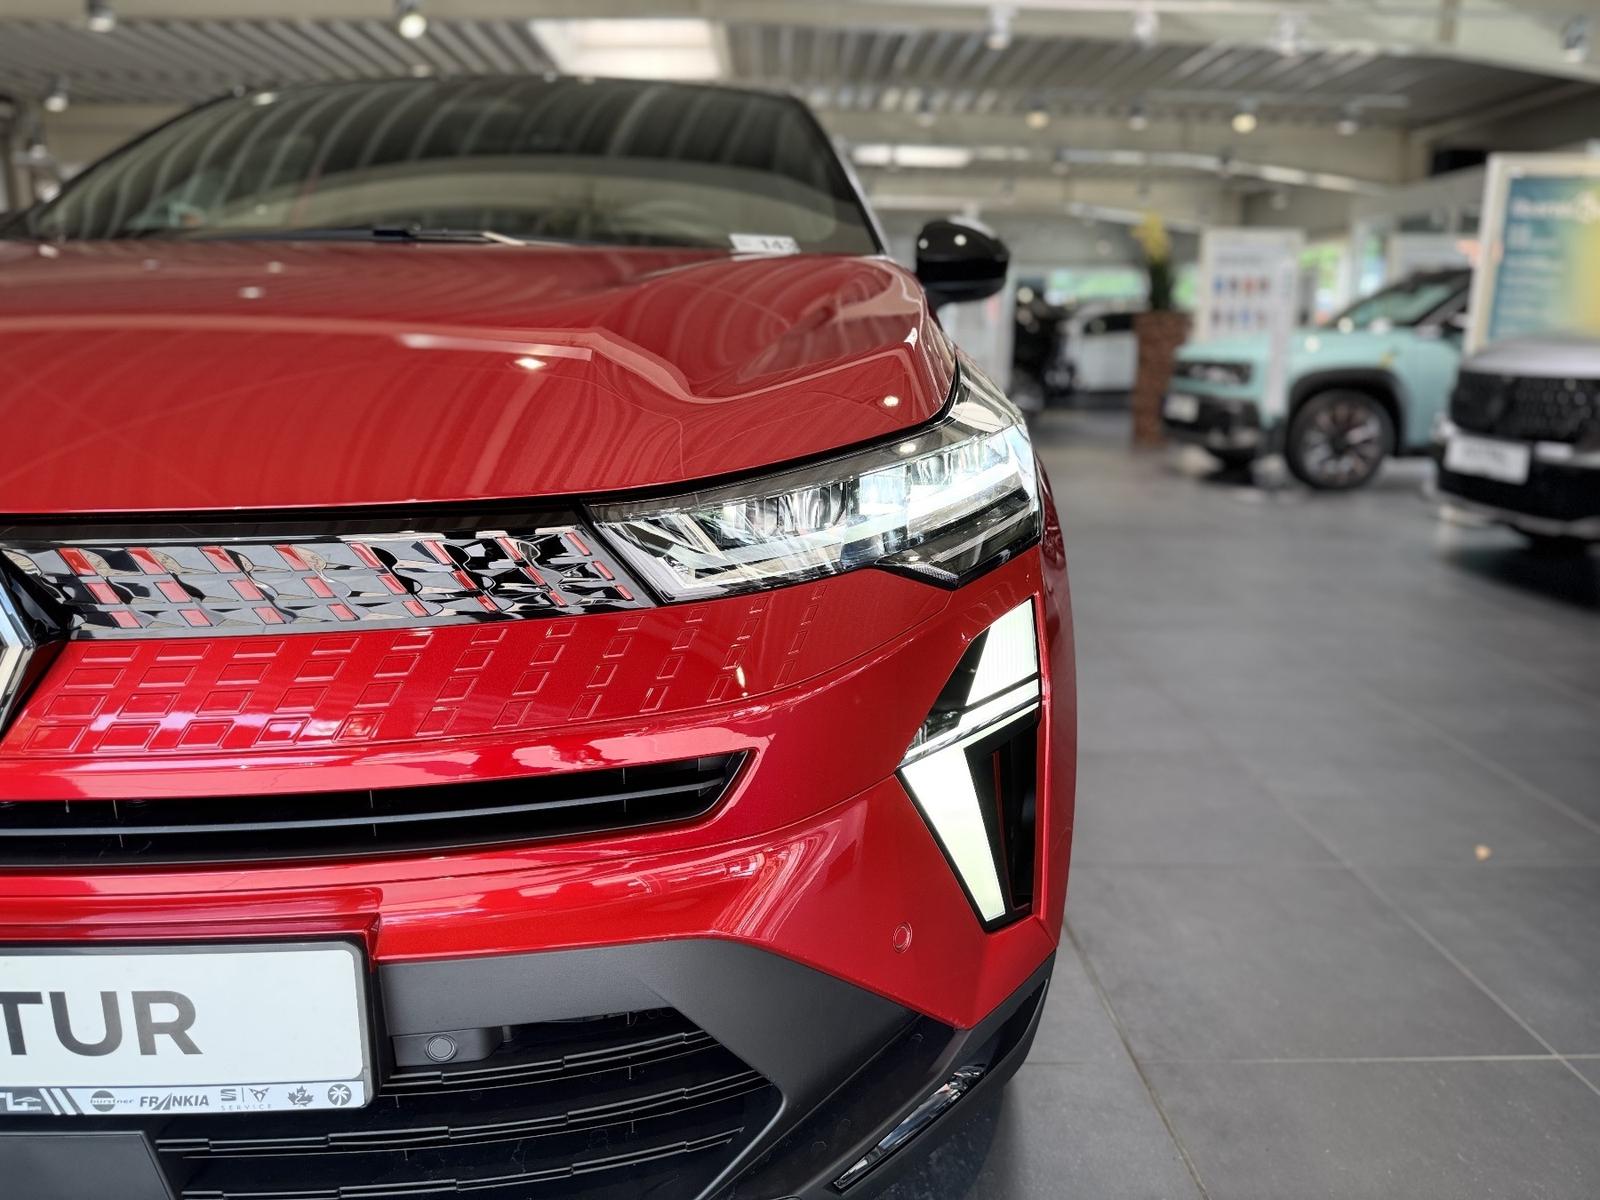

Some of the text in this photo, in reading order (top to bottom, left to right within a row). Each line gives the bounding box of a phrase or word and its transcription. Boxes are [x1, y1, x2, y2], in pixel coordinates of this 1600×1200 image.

[0, 990, 204, 1057] TUR
[139, 1092, 210, 1110] FRANKIA
[220, 1103, 272, 1111] SERVICE
